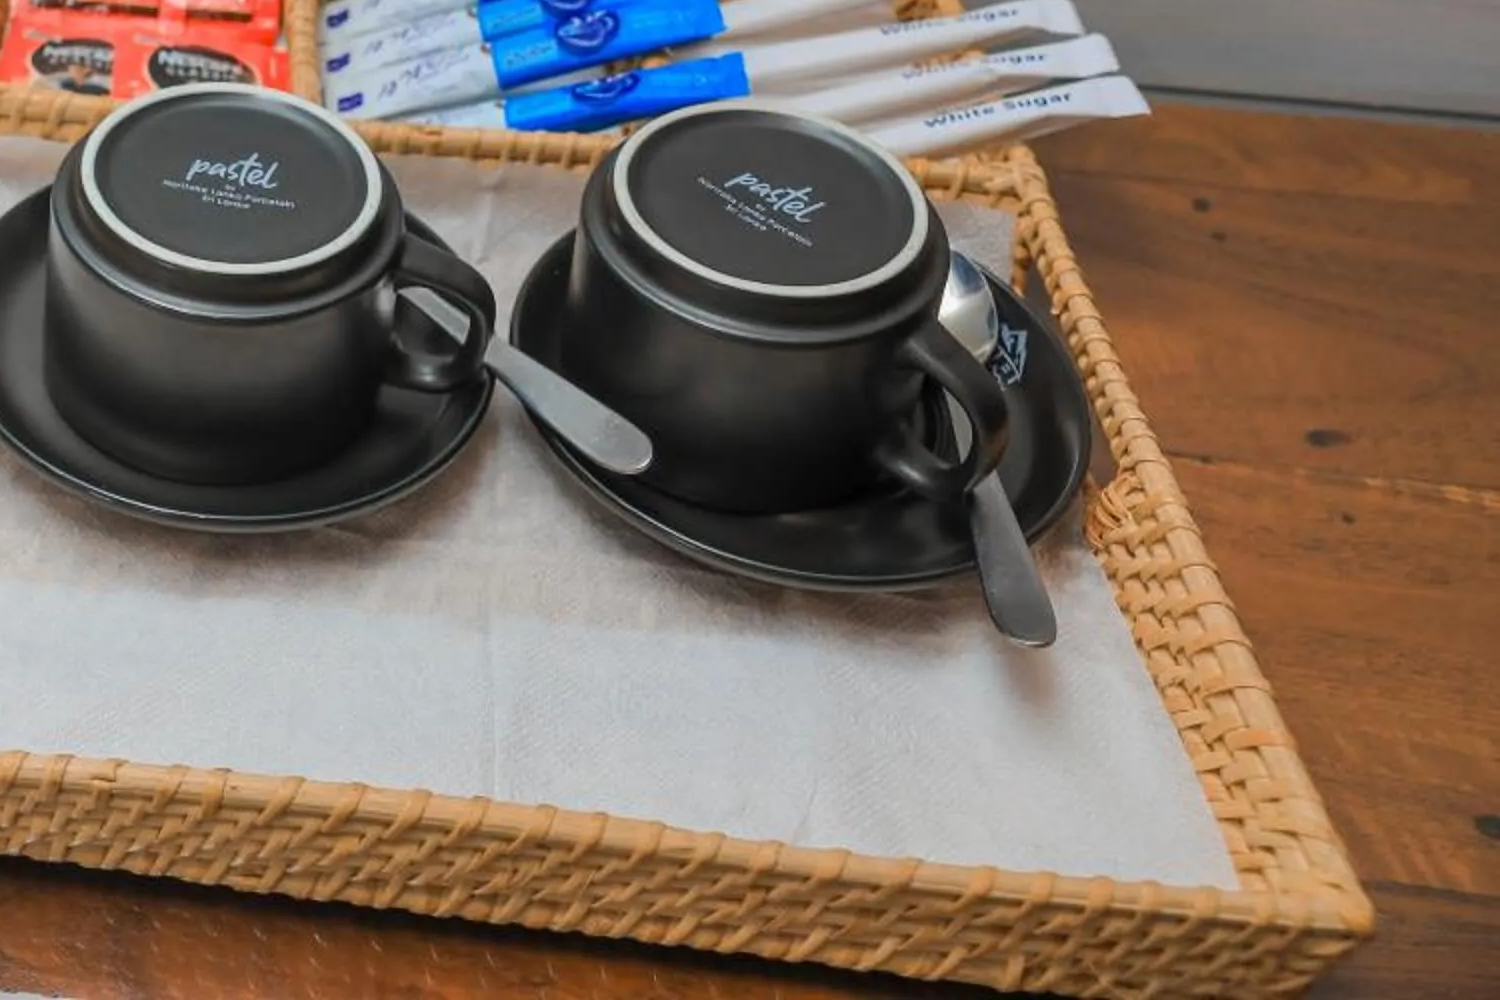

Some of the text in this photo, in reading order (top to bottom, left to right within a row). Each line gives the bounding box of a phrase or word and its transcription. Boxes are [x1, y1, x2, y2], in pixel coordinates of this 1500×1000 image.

[923, 92, 1072, 128] White Sugar
[185, 152, 279, 189] pastel
[723, 172, 827, 223] pastel
